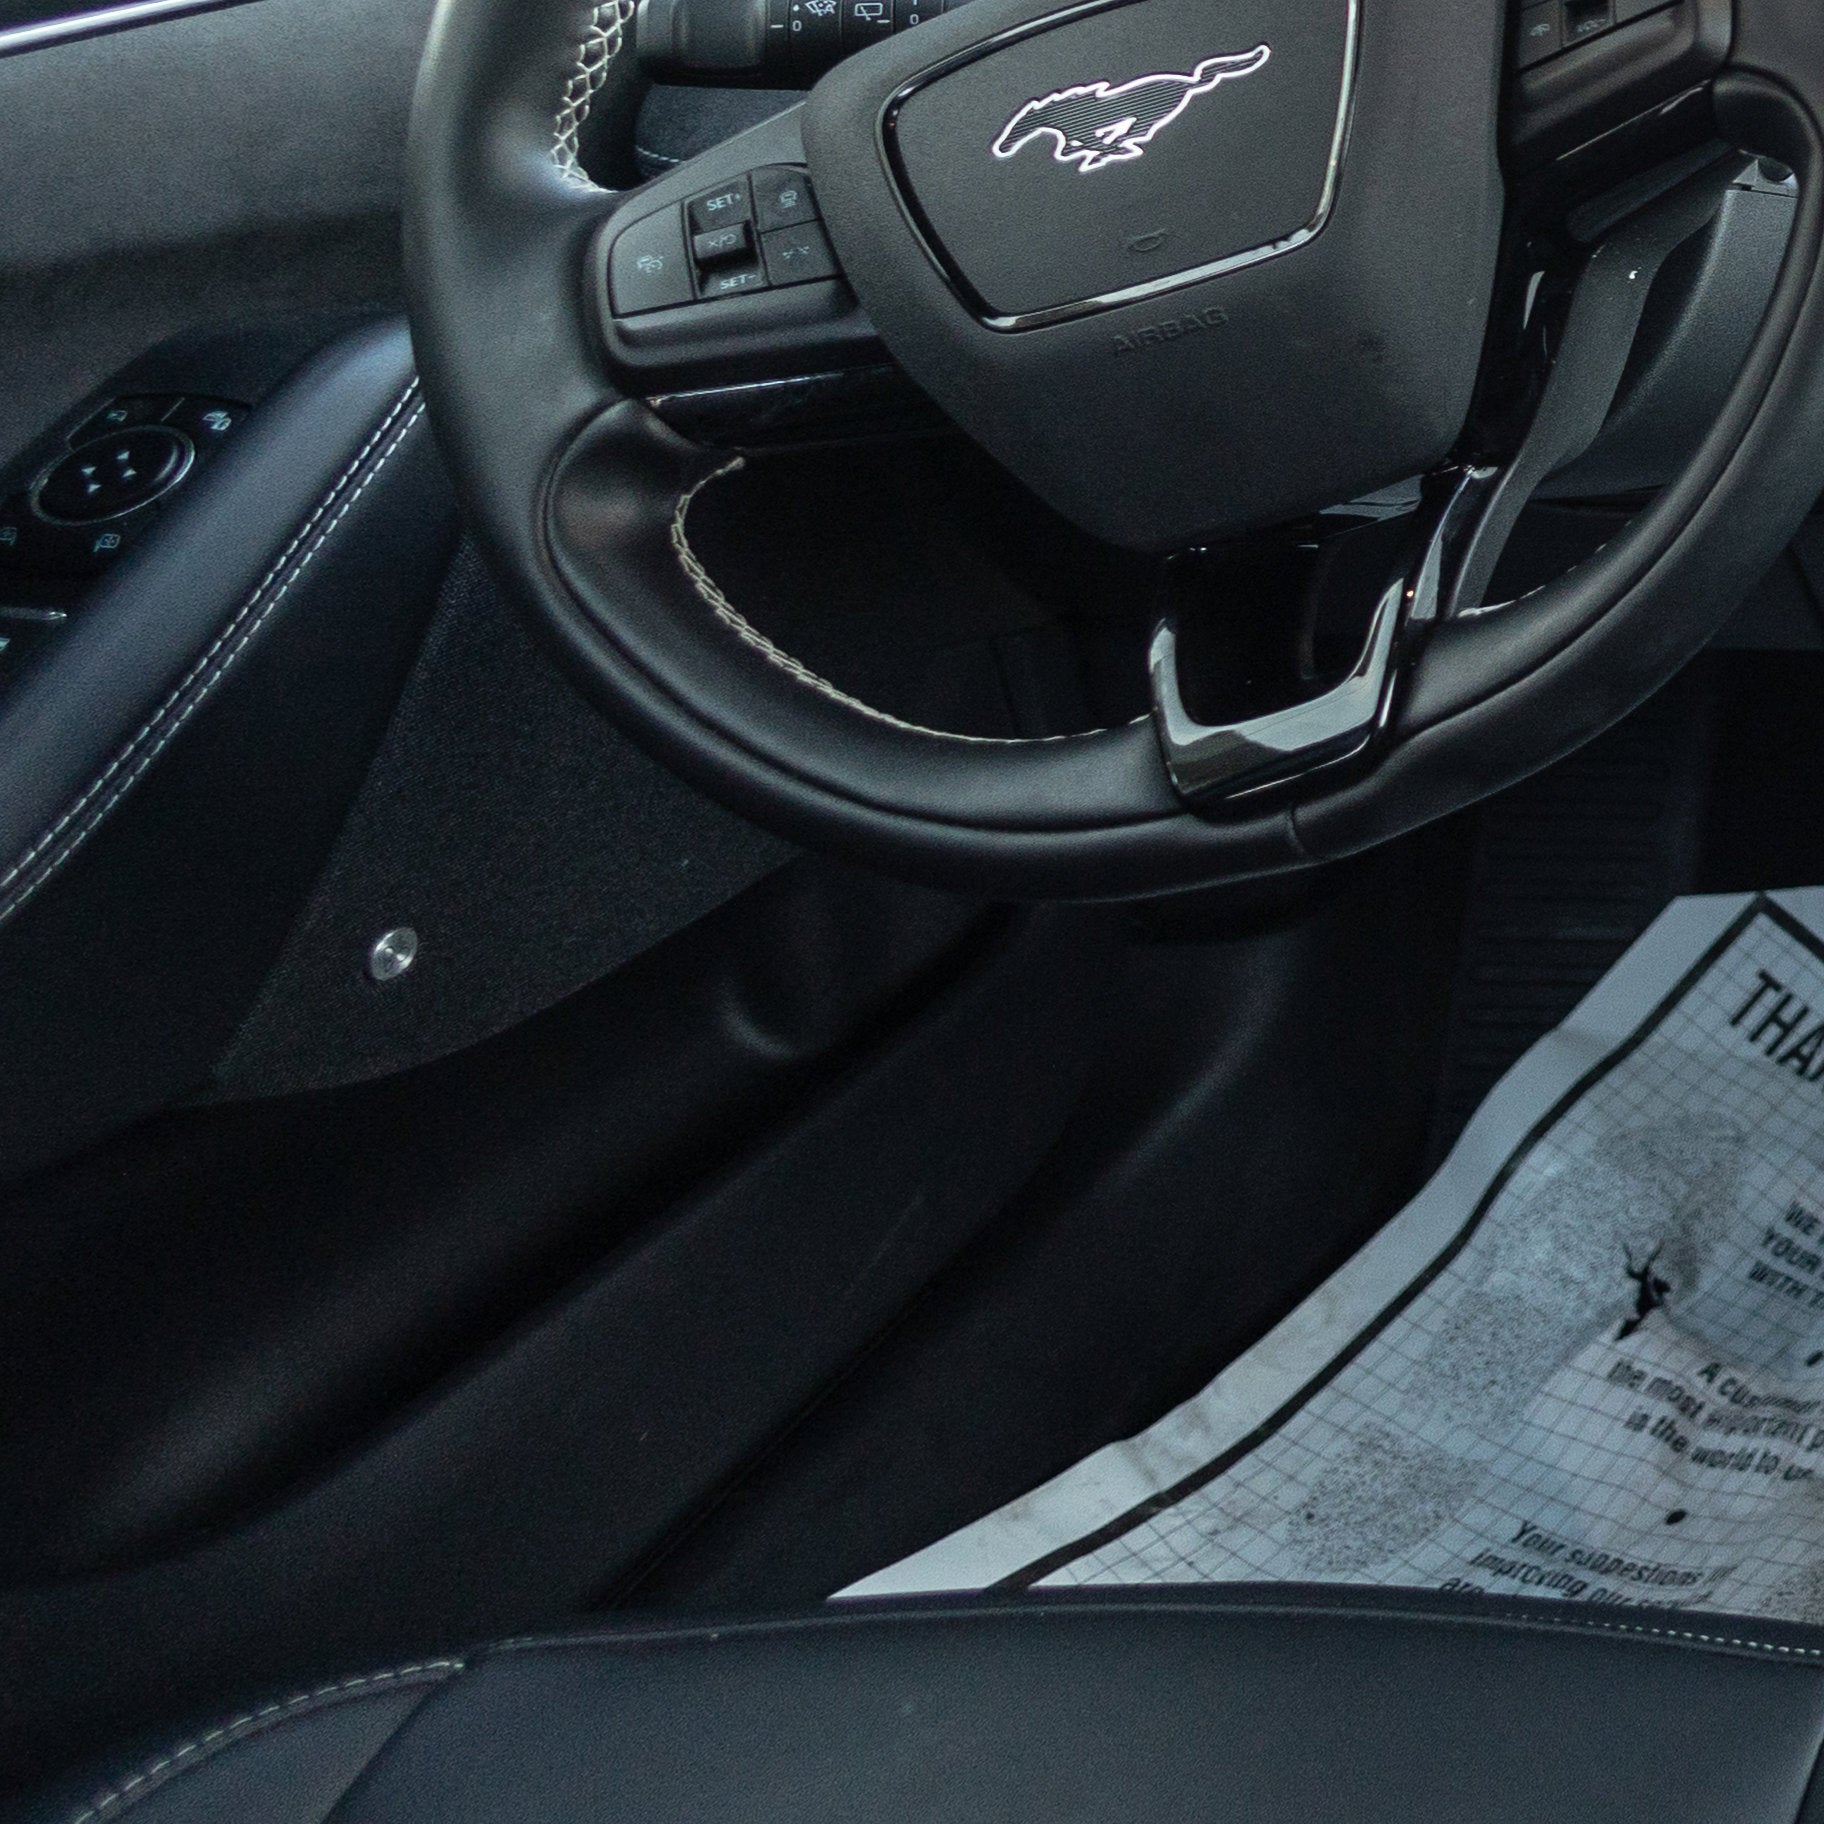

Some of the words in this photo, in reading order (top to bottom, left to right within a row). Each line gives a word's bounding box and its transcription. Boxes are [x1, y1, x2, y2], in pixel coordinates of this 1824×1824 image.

[1110, 306, 1229, 353] AIRBAG
[1783, 1199, 1822, 1237] WE
[1760, 1225, 1823, 1275] YOUR
[1749, 1257, 1809, 1299] WITH
[1645, 1375, 1706, 1419] most
[1649, 1414, 1690, 1454] the
[1509, 1518, 1566, 1558] Your
